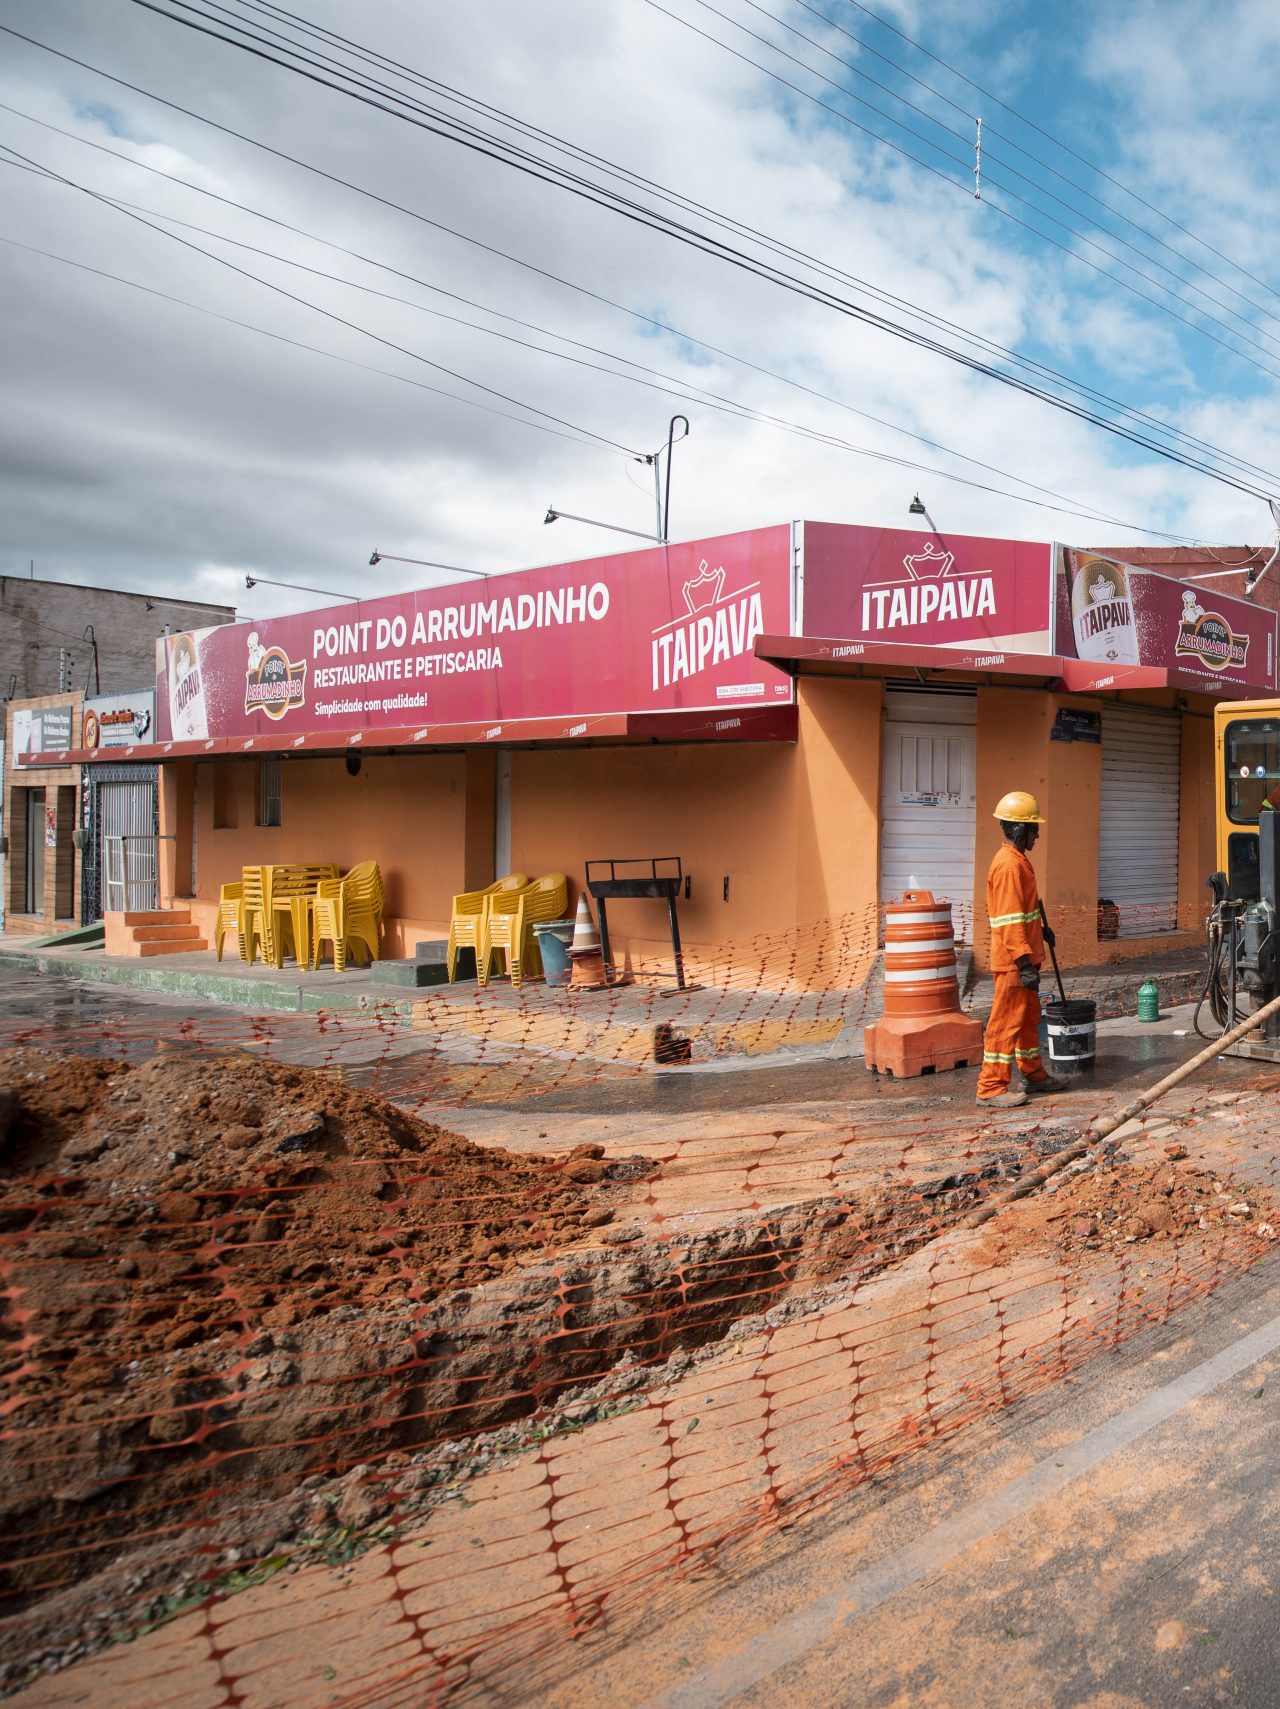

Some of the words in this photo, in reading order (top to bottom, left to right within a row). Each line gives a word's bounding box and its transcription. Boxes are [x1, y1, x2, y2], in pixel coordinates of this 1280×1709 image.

[861, 577, 997, 631] ITAIPAVA
[313, 620, 373, 659] POINT
[376, 615, 407, 650] DO
[411, 582, 610, 646] ARRUMADINHO
[1202, 622, 1227, 638] POINT
[652, 592, 764, 691] ITAIPAVA
[832, 644, 865, 658] ITAIPAVA
[1179, 632, 1245, 661] ARRUMADINHO
[264, 660, 286, 677] POINT
[314, 659, 402, 688] RESTAURANTE
[404, 657, 413, 679] E
[415, 647, 503, 677] PETISCARIA
[974, 655, 1005, 667] ITAIPAVA
[247, 679, 302, 702] ARRUMADINHO
[315, 698, 363, 718] Simplicidade
[364, 699, 381, 711] com
[382, 692, 428, 714] qualidade!
[715, 718, 741, 731] ITAIPAVA
